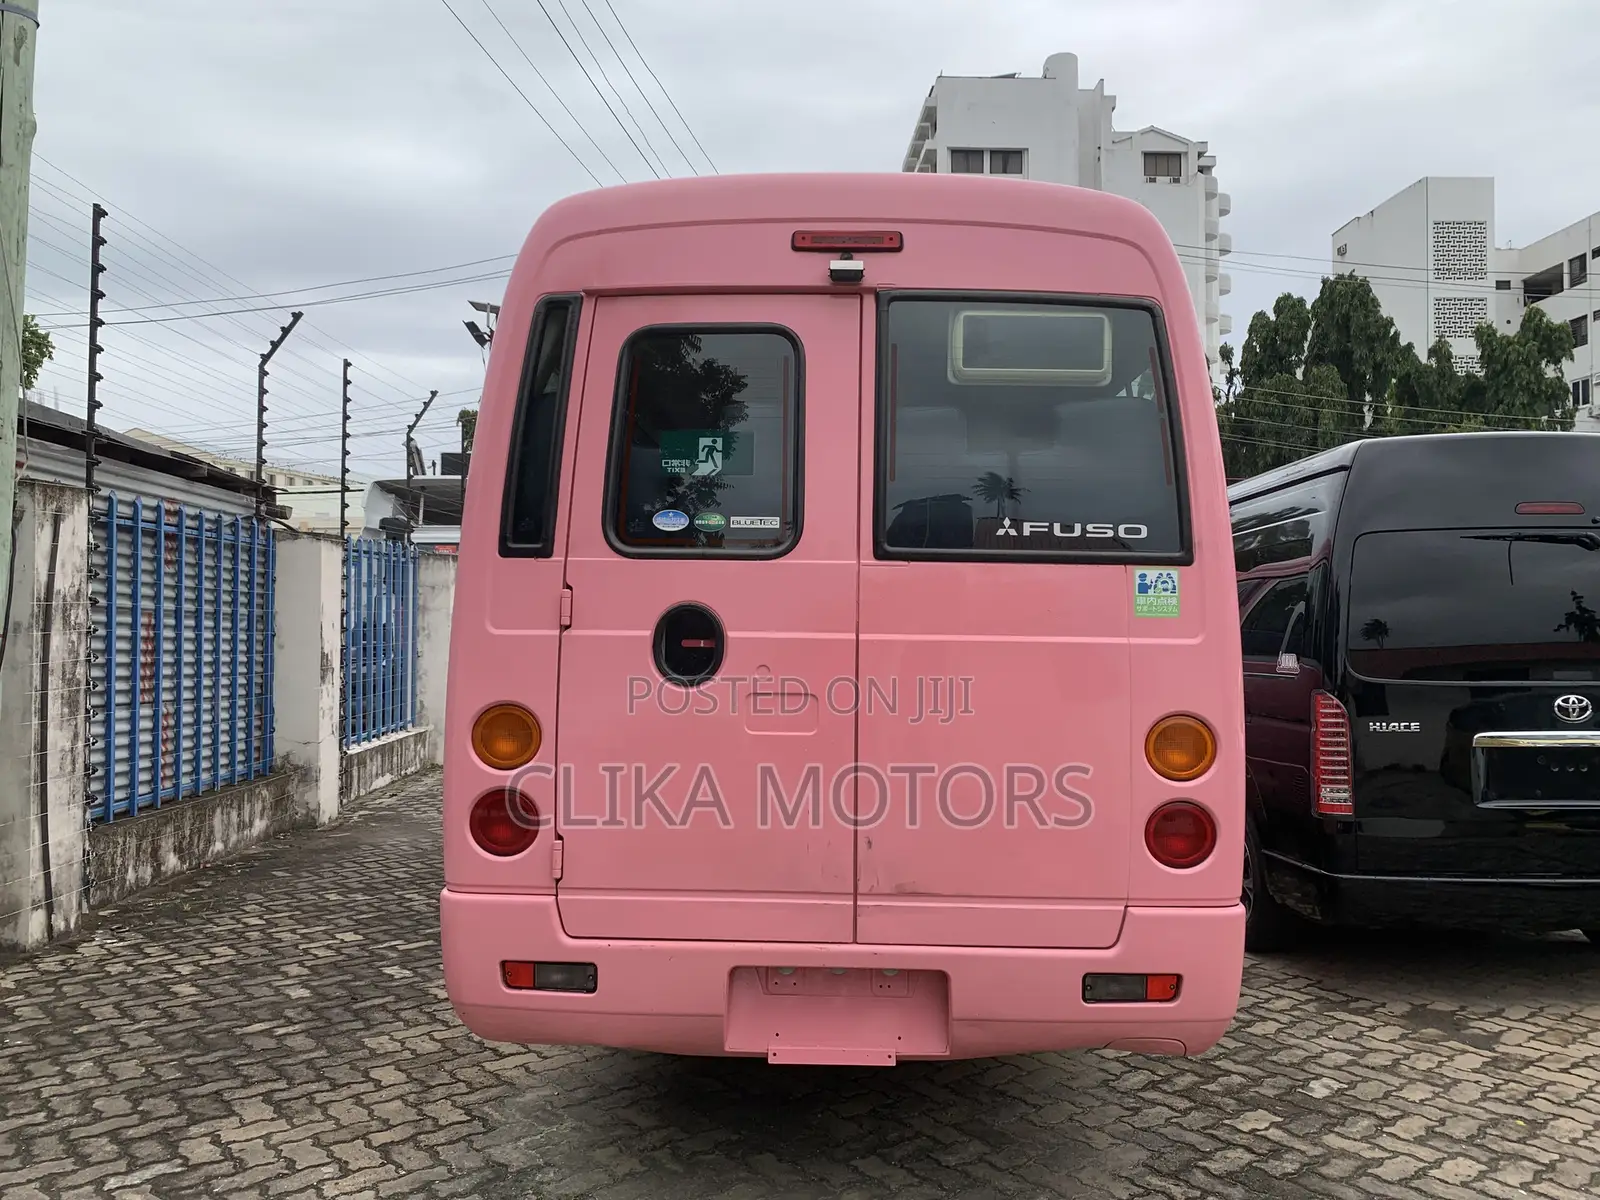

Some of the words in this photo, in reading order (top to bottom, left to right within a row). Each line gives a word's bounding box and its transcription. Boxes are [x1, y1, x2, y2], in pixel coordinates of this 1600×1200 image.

[731, 518, 778, 526] BLUETEC
[1022, 522, 1148, 539] FUSO
[1369, 721, 1421, 732] HIACE
